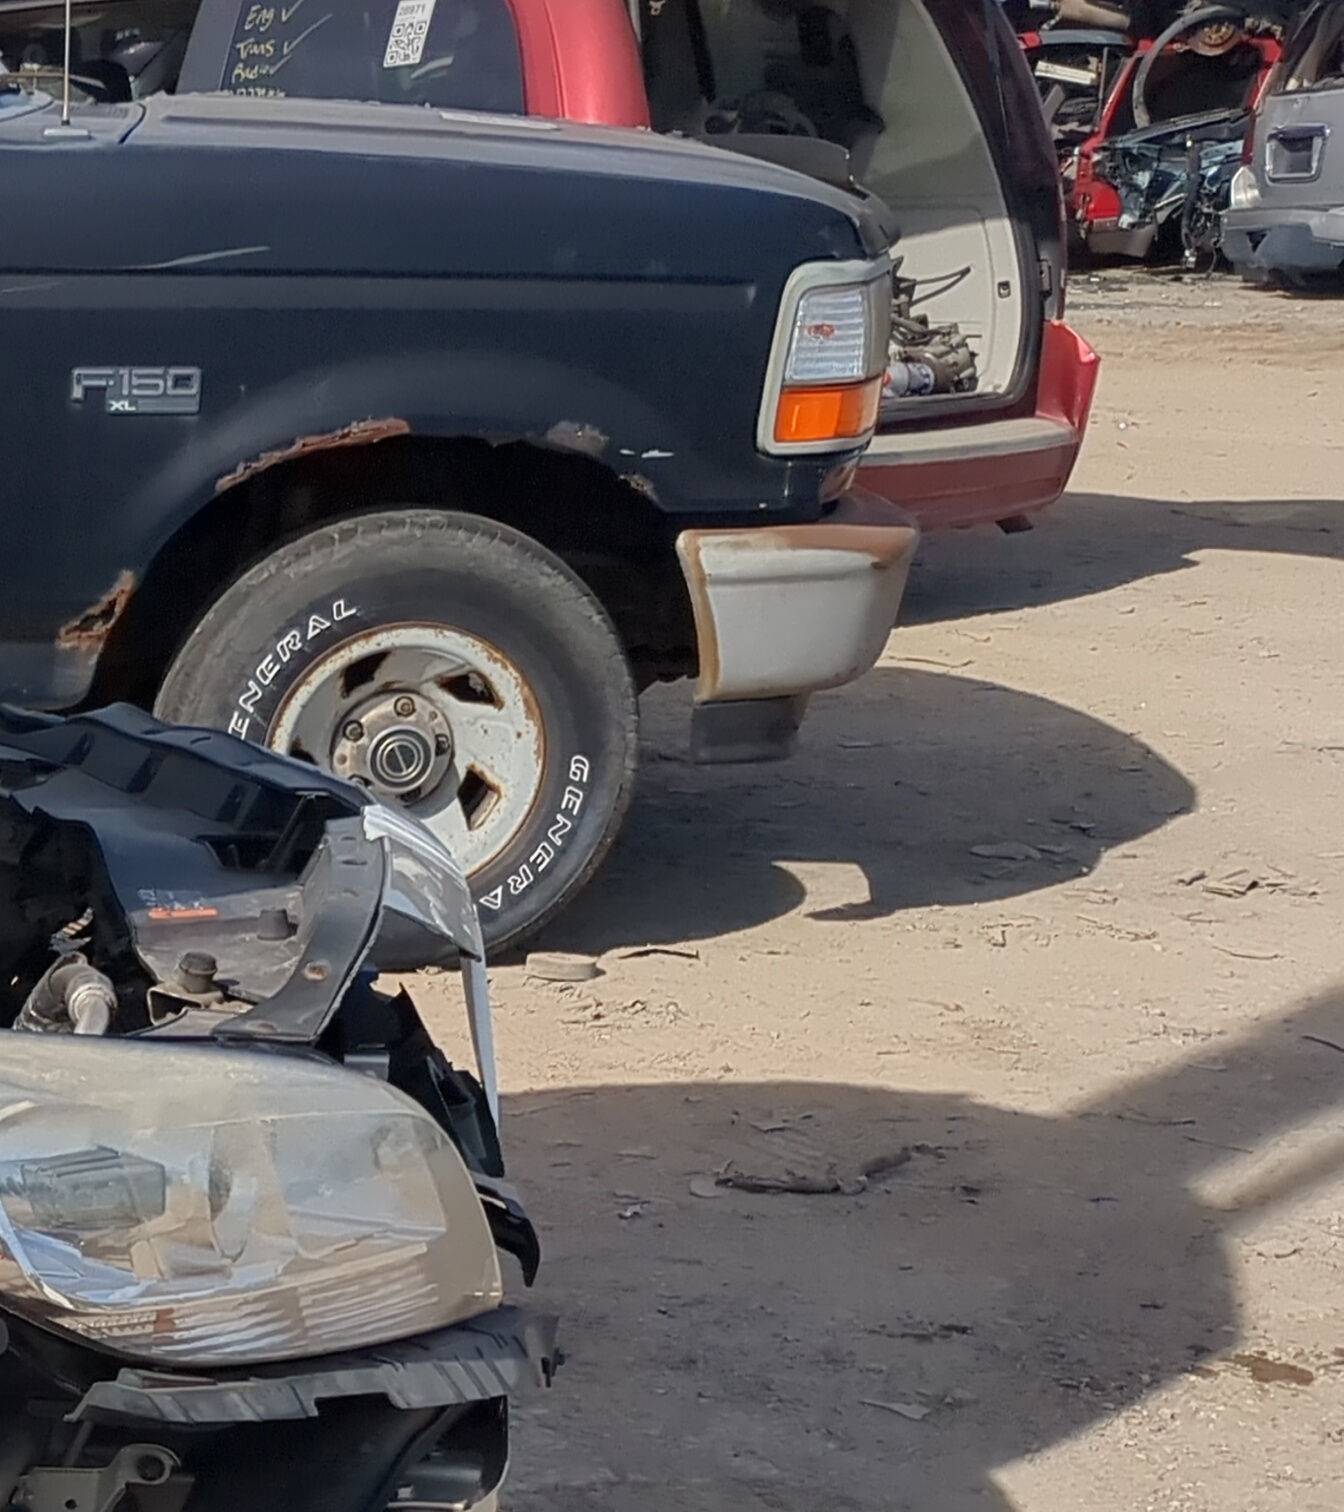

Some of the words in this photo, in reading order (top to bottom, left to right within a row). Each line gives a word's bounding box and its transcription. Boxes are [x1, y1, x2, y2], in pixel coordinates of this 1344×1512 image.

[109, 400, 137, 412] XL
[227, 598, 359, 741] ENERAL
[478, 753, 591, 910] GENERA
